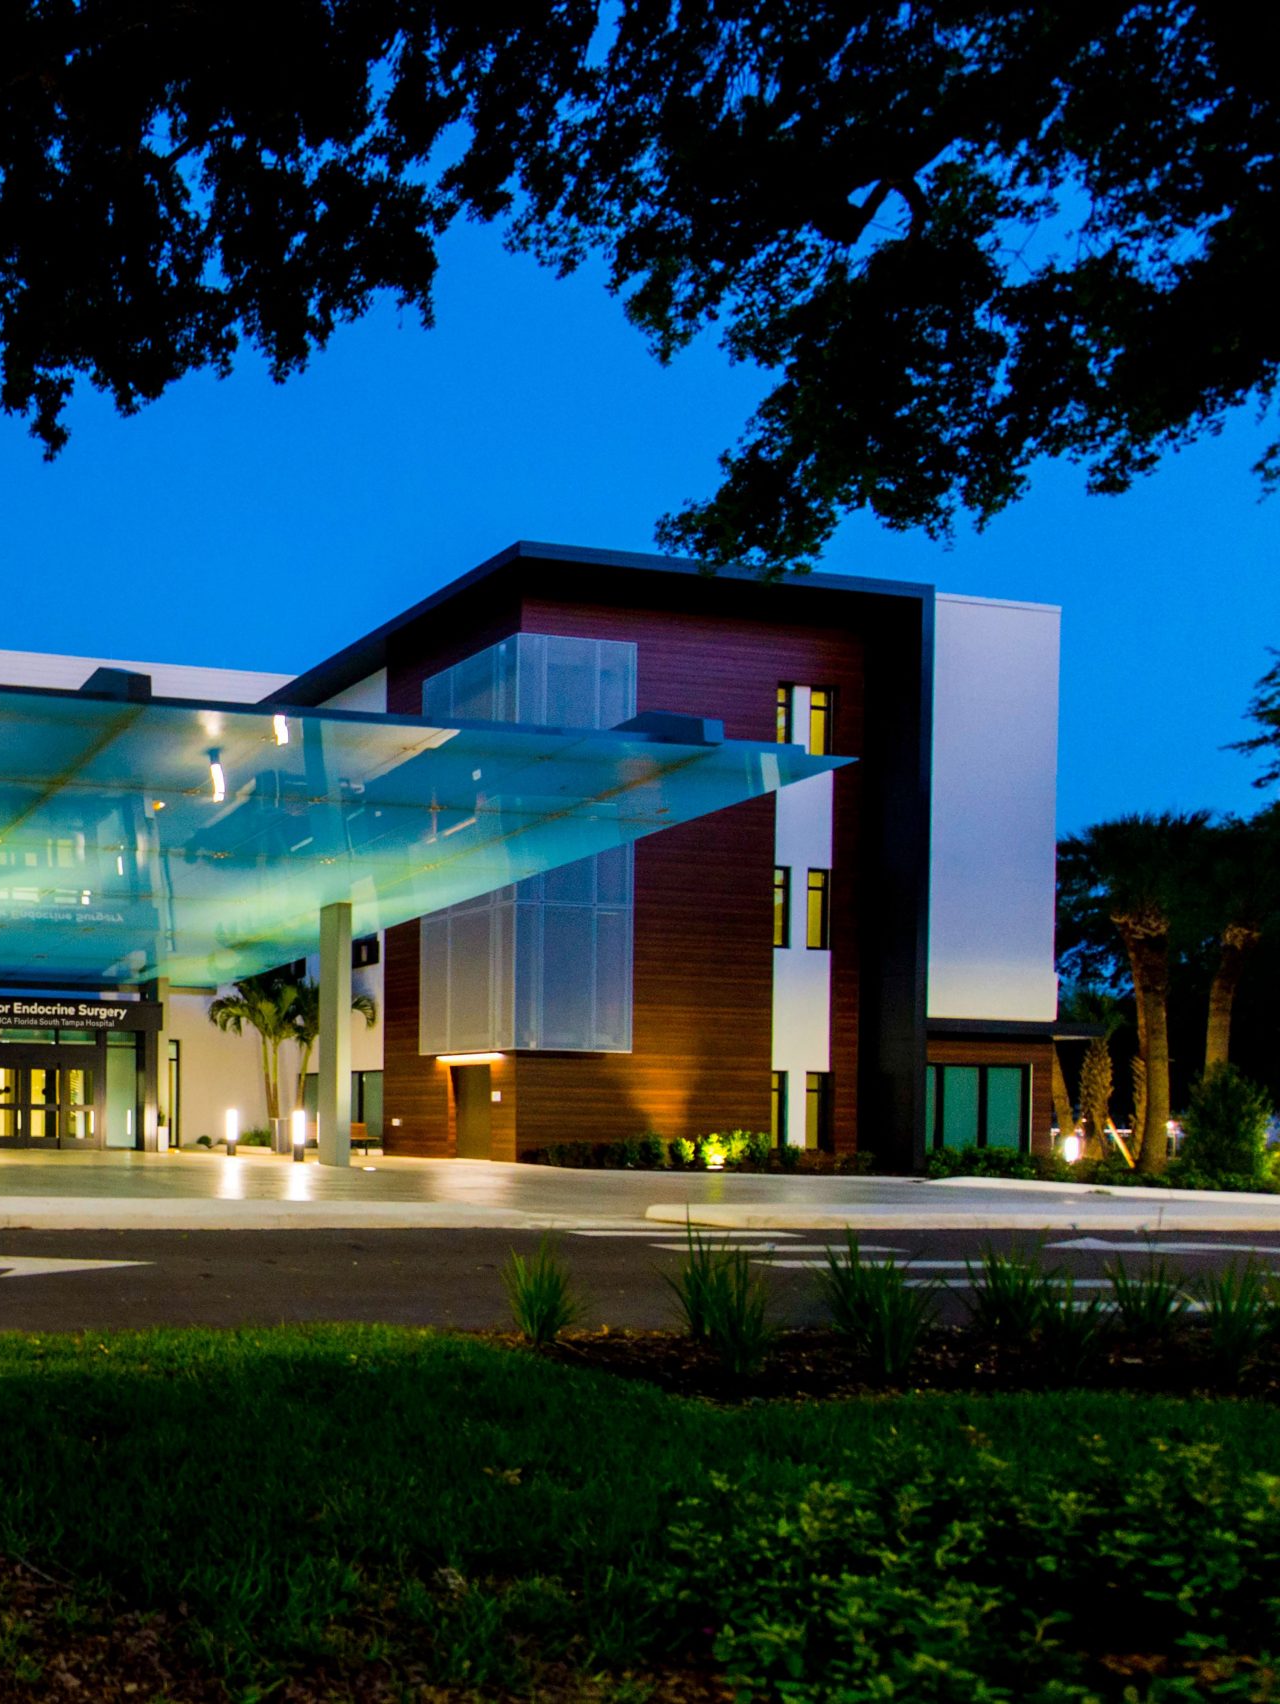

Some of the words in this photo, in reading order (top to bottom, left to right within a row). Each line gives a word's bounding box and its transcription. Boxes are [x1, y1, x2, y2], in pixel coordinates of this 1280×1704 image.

[13, 1002, 76, 1016] Endocrine
[78, 1004, 127, 1020] Surgery
[14, 1017, 38, 1025] Florida
[39, 1018, 60, 1026] South
[61, 1019, 85, 1027] Tampa
[86, 1019, 115, 1028] Hospital
